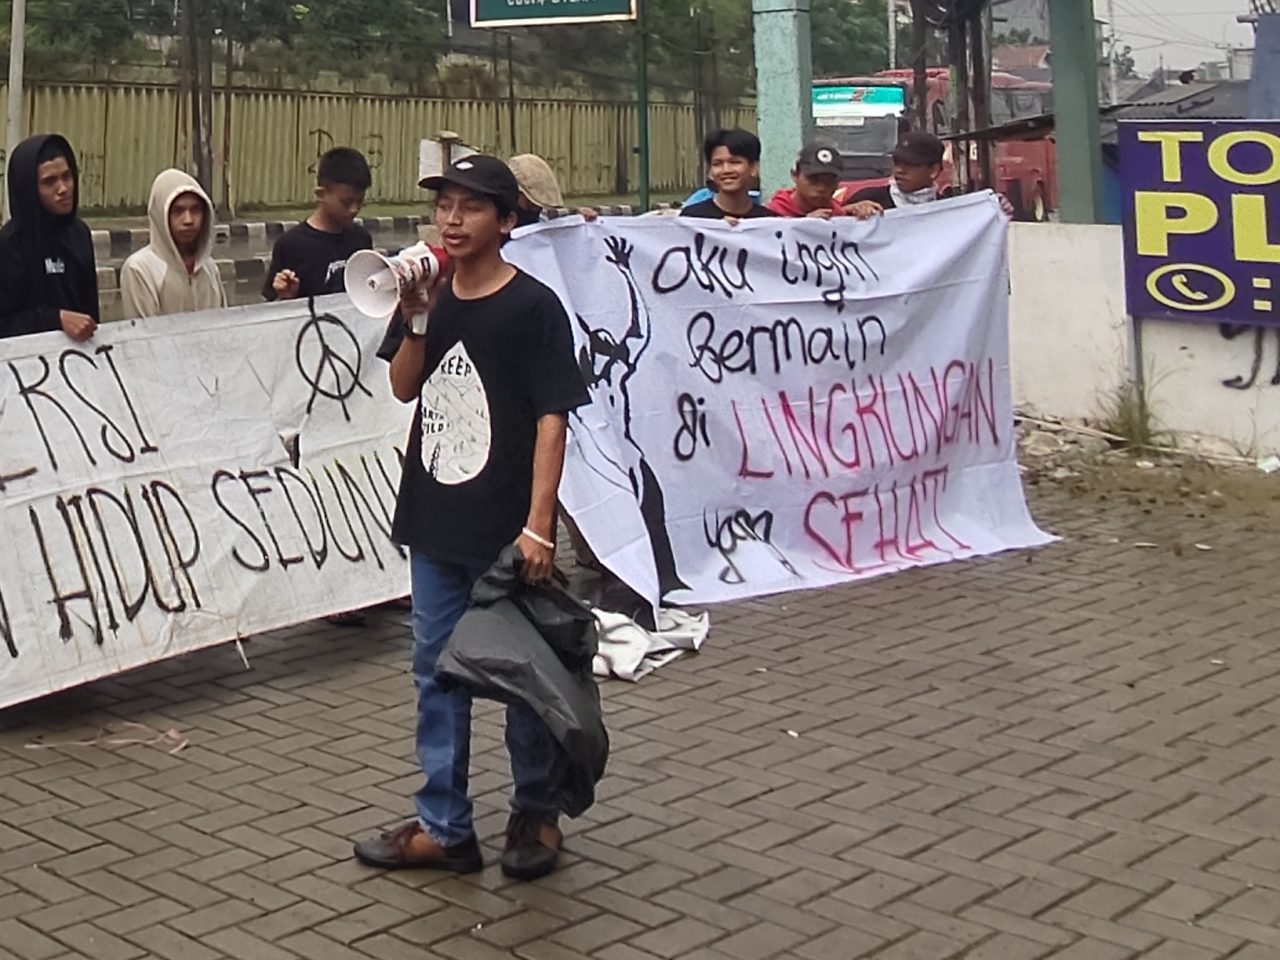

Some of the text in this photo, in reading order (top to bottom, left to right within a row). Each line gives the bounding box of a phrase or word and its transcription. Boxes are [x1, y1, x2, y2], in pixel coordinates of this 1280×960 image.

[1137, 130, 1280, 185] TO
[1135, 190, 1280, 262] PL
[652, 230, 880, 314] aku ingin
[440, 355, 472, 377] KEEP
[731, 357, 1000, 479] LINGKUNGAN
[28, 479, 201, 647] HIDUP
